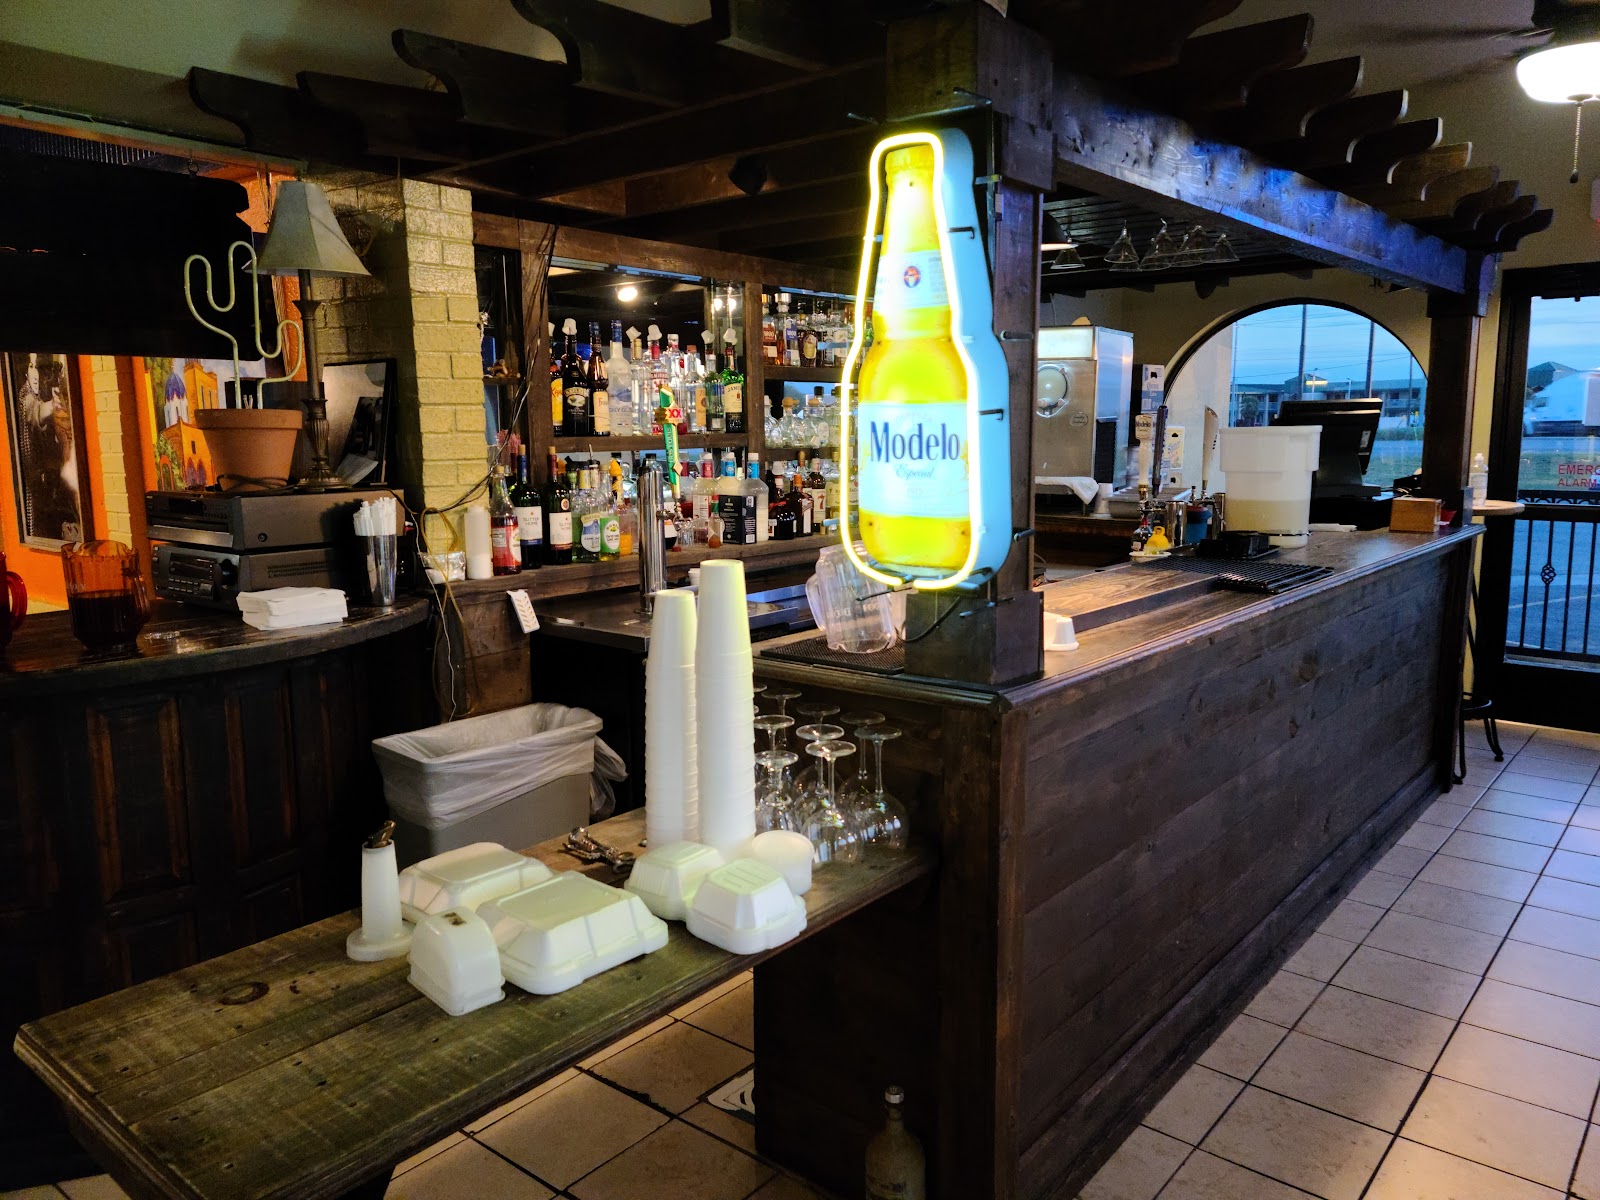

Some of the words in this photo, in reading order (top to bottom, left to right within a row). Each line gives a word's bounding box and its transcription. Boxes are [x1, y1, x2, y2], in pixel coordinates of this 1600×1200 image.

[667, 408, 682, 418] XX
[870, 421, 961, 463] Modelo
[895, 463, 935, 481] Especial
[1557, 478, 1598, 488] ALARM
